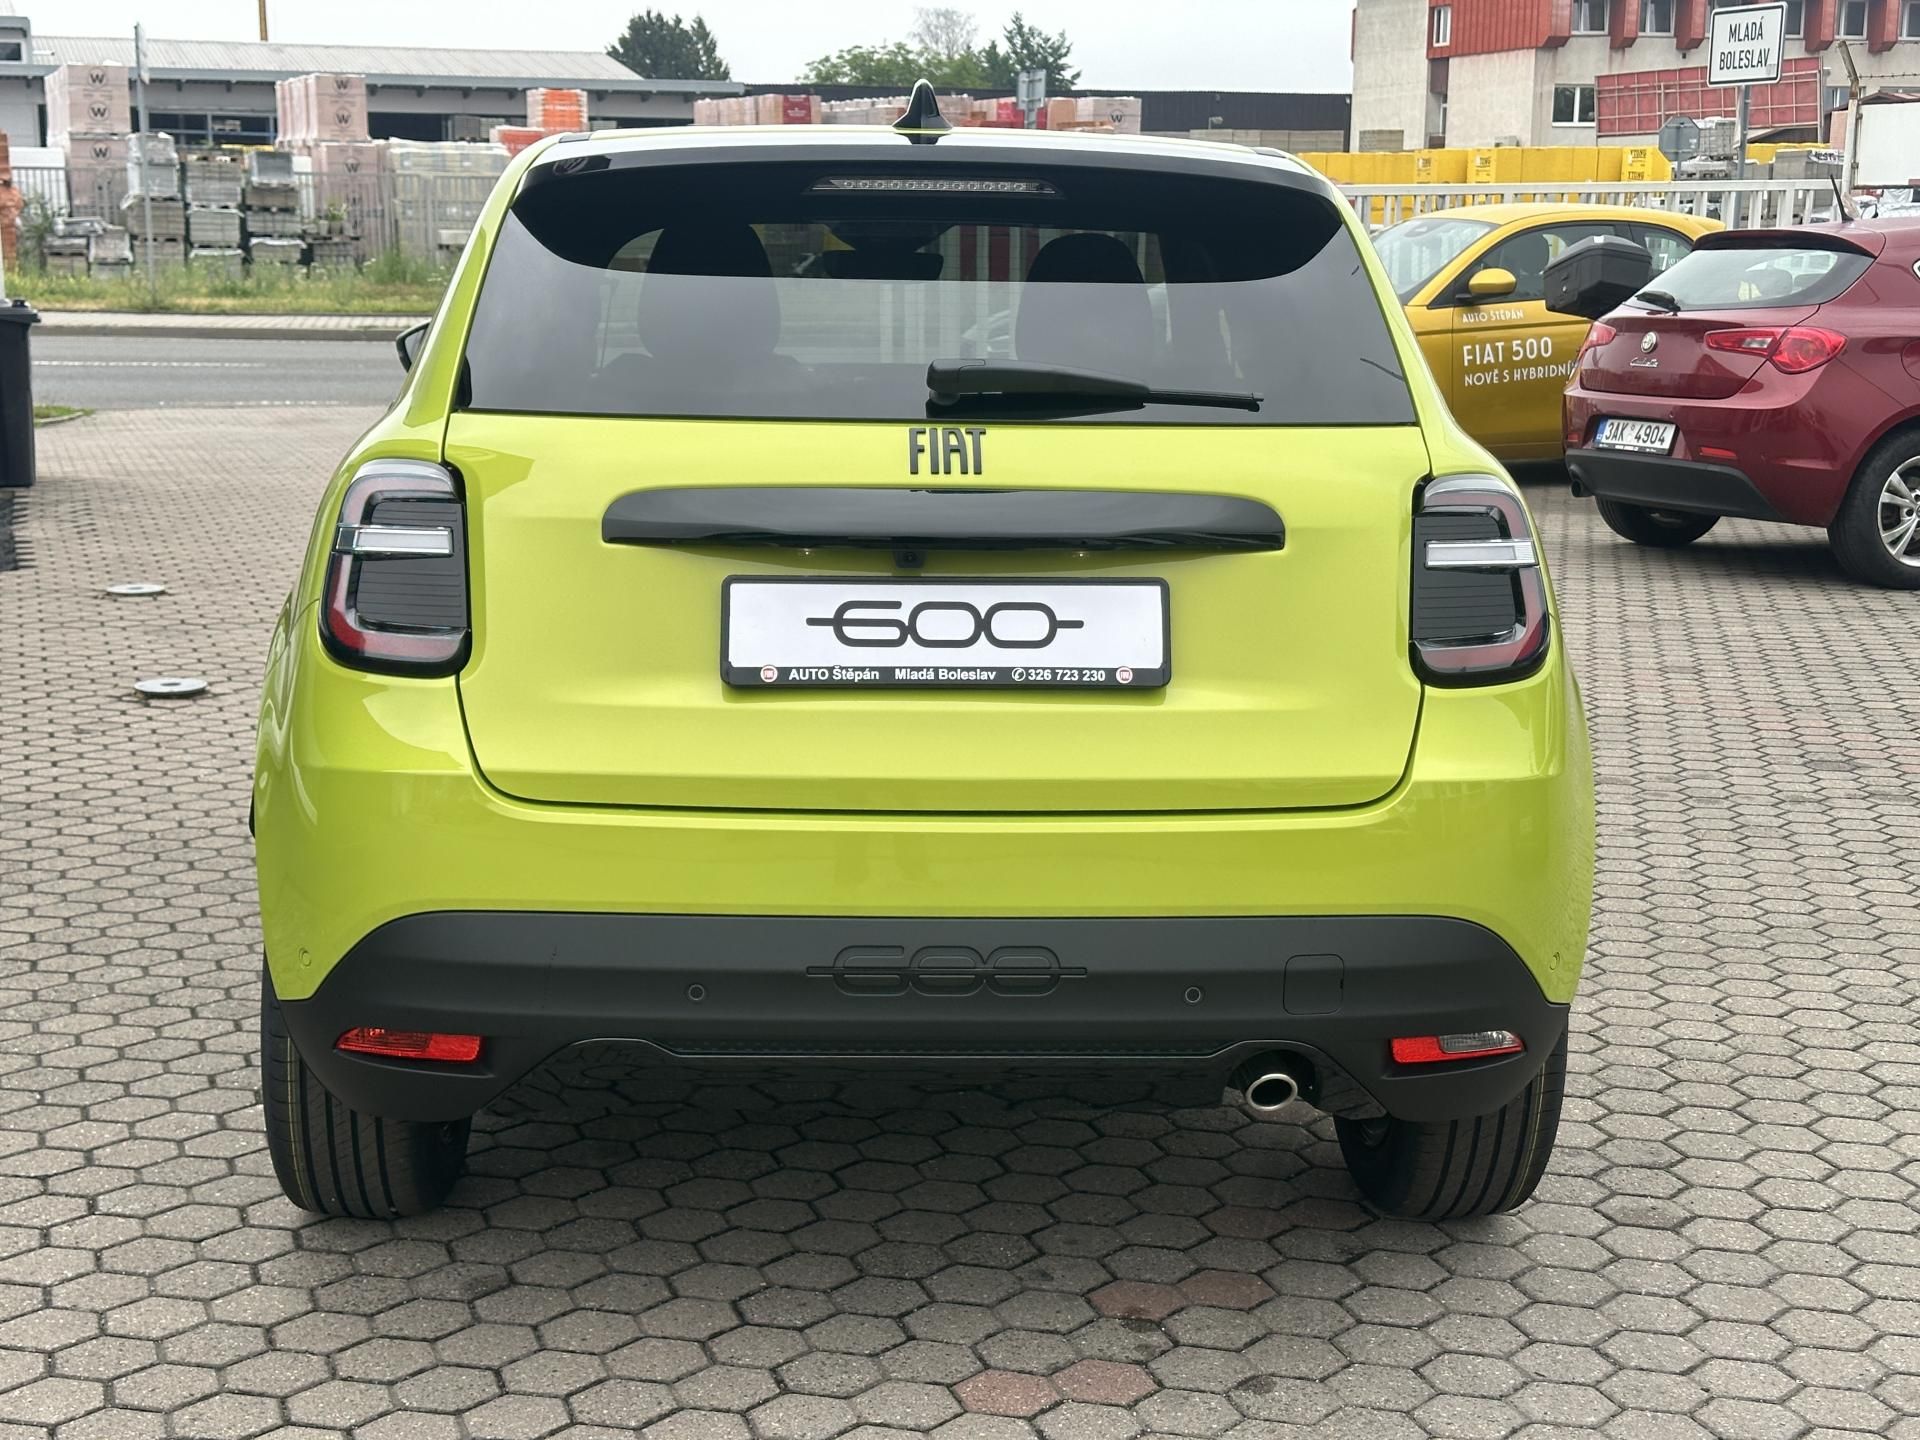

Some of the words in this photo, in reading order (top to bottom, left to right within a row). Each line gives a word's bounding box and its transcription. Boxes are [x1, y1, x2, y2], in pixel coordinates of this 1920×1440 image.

[1728, 16, 1764, 43] MLADÁ
[1719, 47, 1770, 71] BOLESLAV
[1462, 312, 1488, 323] AUTO
[1463, 342, 1504, 366] FIAT
[1512, 336, 1552, 361] 500
[1464, 368, 1499, 387] NOVĚ
[1503, 369, 1510, 383] S
[1513, 360, 1575, 382] HYBRIDNÍ
[1605, 421, 1629, 441] 3AK
[1634, 424, 1668, 446] 4904
[909, 428, 986, 475] FIAT
[789, 668, 829, 680] AUTO
[832, 665, 879, 682] Štěpán
[894, 667, 934, 681] Mladá
[938, 668, 996, 682] Boleslav
[1028, 669, 1052, 681] 326
[1055, 669, 1079, 682] 723
[1082, 670, 1106, 682] 230
